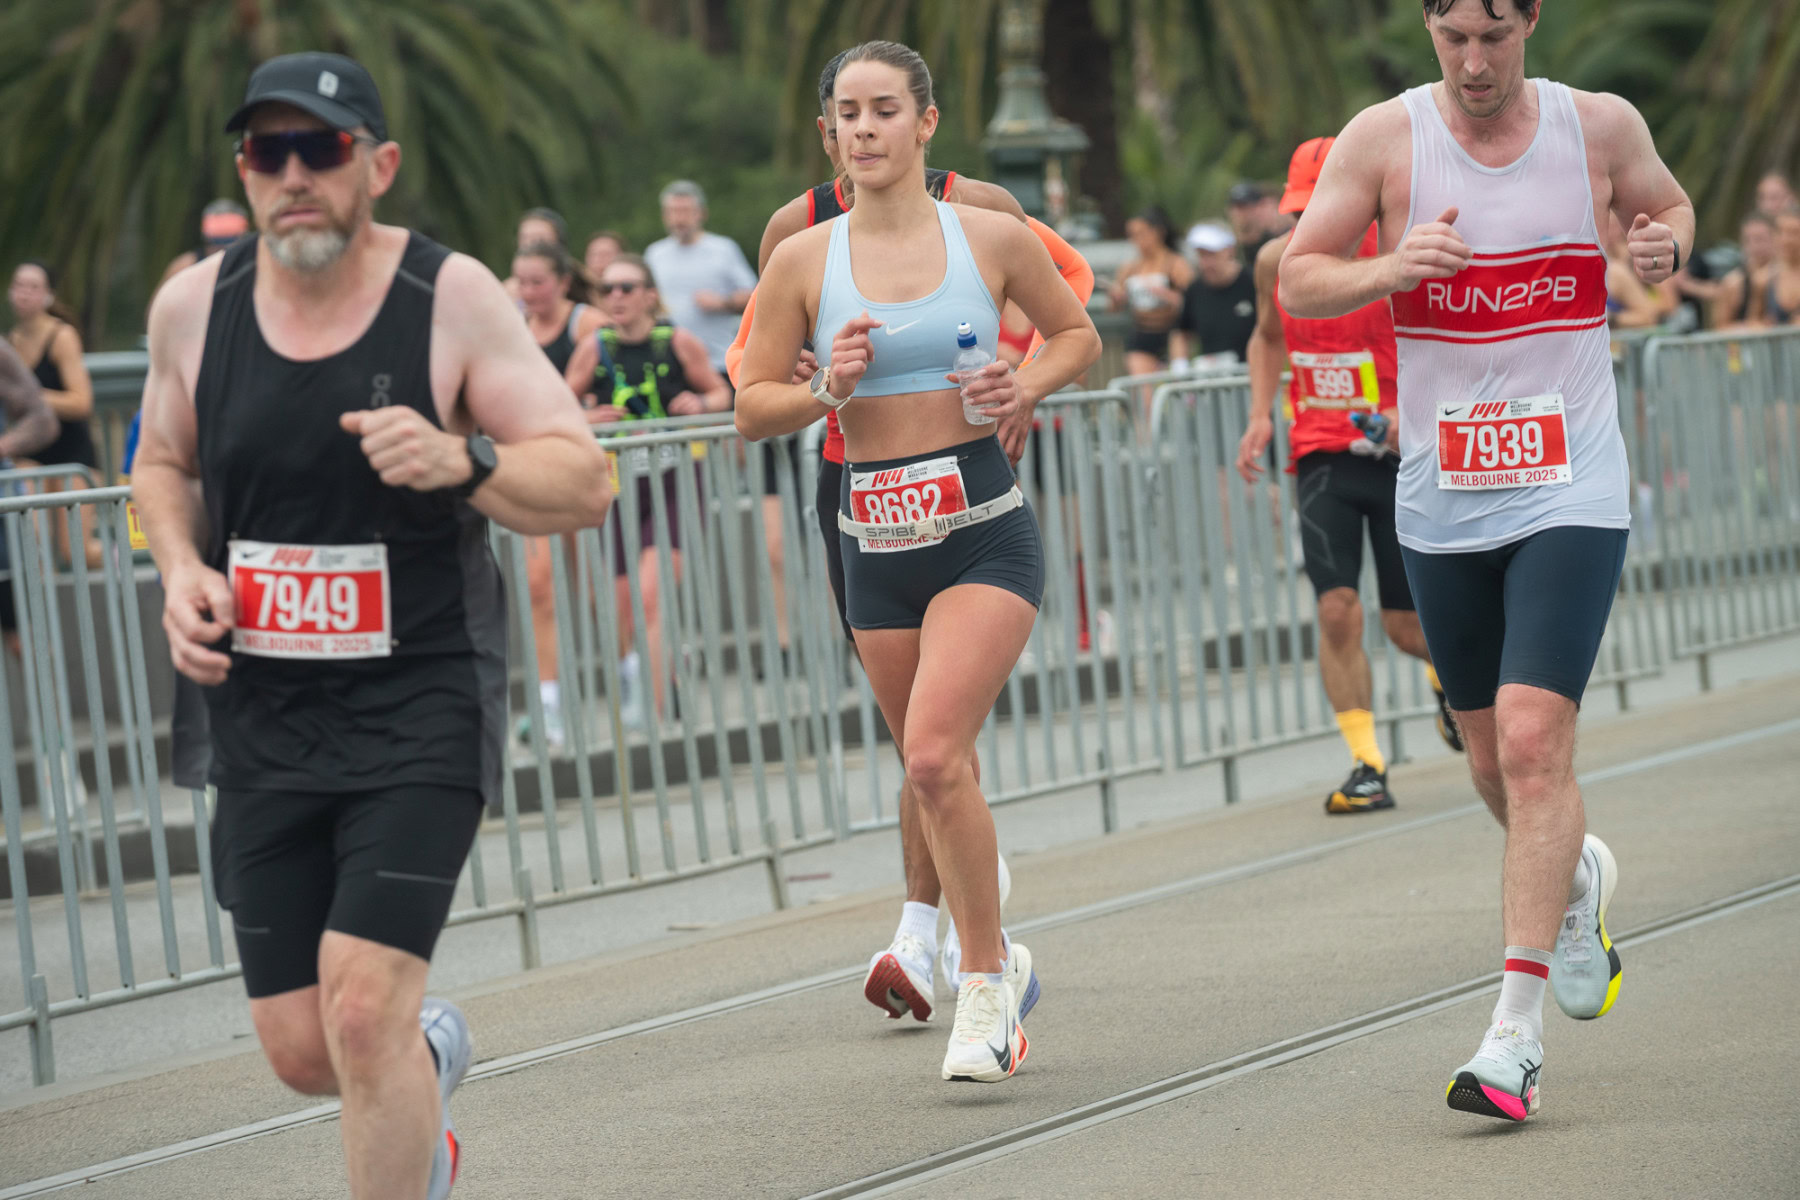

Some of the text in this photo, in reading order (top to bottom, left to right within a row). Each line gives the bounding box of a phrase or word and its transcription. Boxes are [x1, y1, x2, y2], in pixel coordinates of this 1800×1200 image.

[1427, 276, 1577, 313] RUN2PB
[1313, 368, 1355, 397] 599
[1457, 421, 1544, 468] 7939
[1451, 468, 1558, 486] MELBOURNE 2025
[864, 483, 942, 524] 8682
[253, 572, 359, 631] 7949
[243, 635, 324, 652] MELBOURNE
